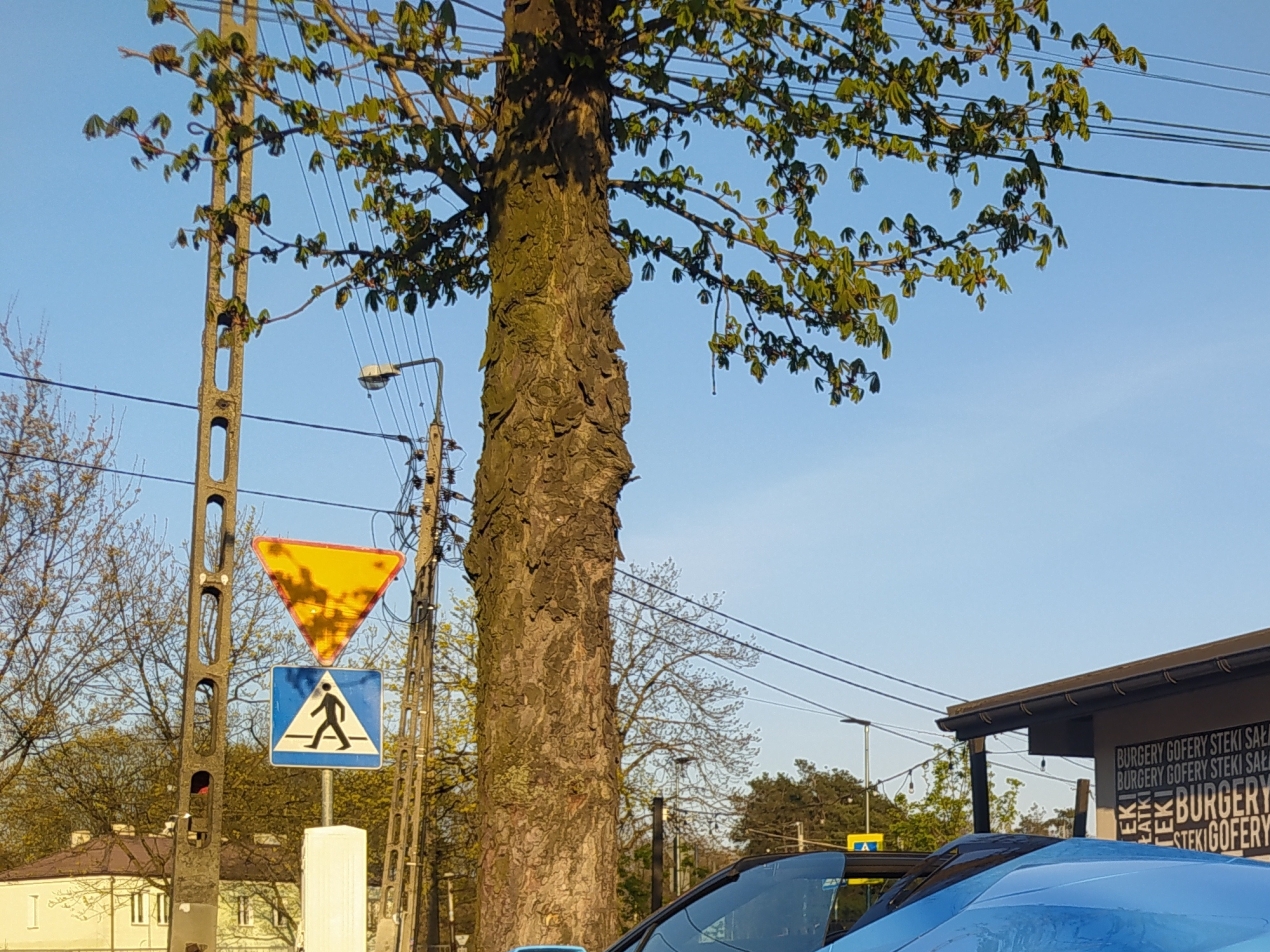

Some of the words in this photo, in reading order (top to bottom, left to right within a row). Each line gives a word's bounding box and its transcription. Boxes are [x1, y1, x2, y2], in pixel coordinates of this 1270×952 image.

[1117, 742, 1165, 768] BURGERY
[1166, 735, 1208, 760] GOFERY
[1210, 728, 1242, 755] STEKI
[1117, 765, 1165, 791] BURGERY
[1166, 759, 1208, 784] GOFERY
[1210, 753, 1242, 778] STEKI
[1154, 790, 1174, 846] TEKI
[1173, 828, 1207, 852] STEKI
